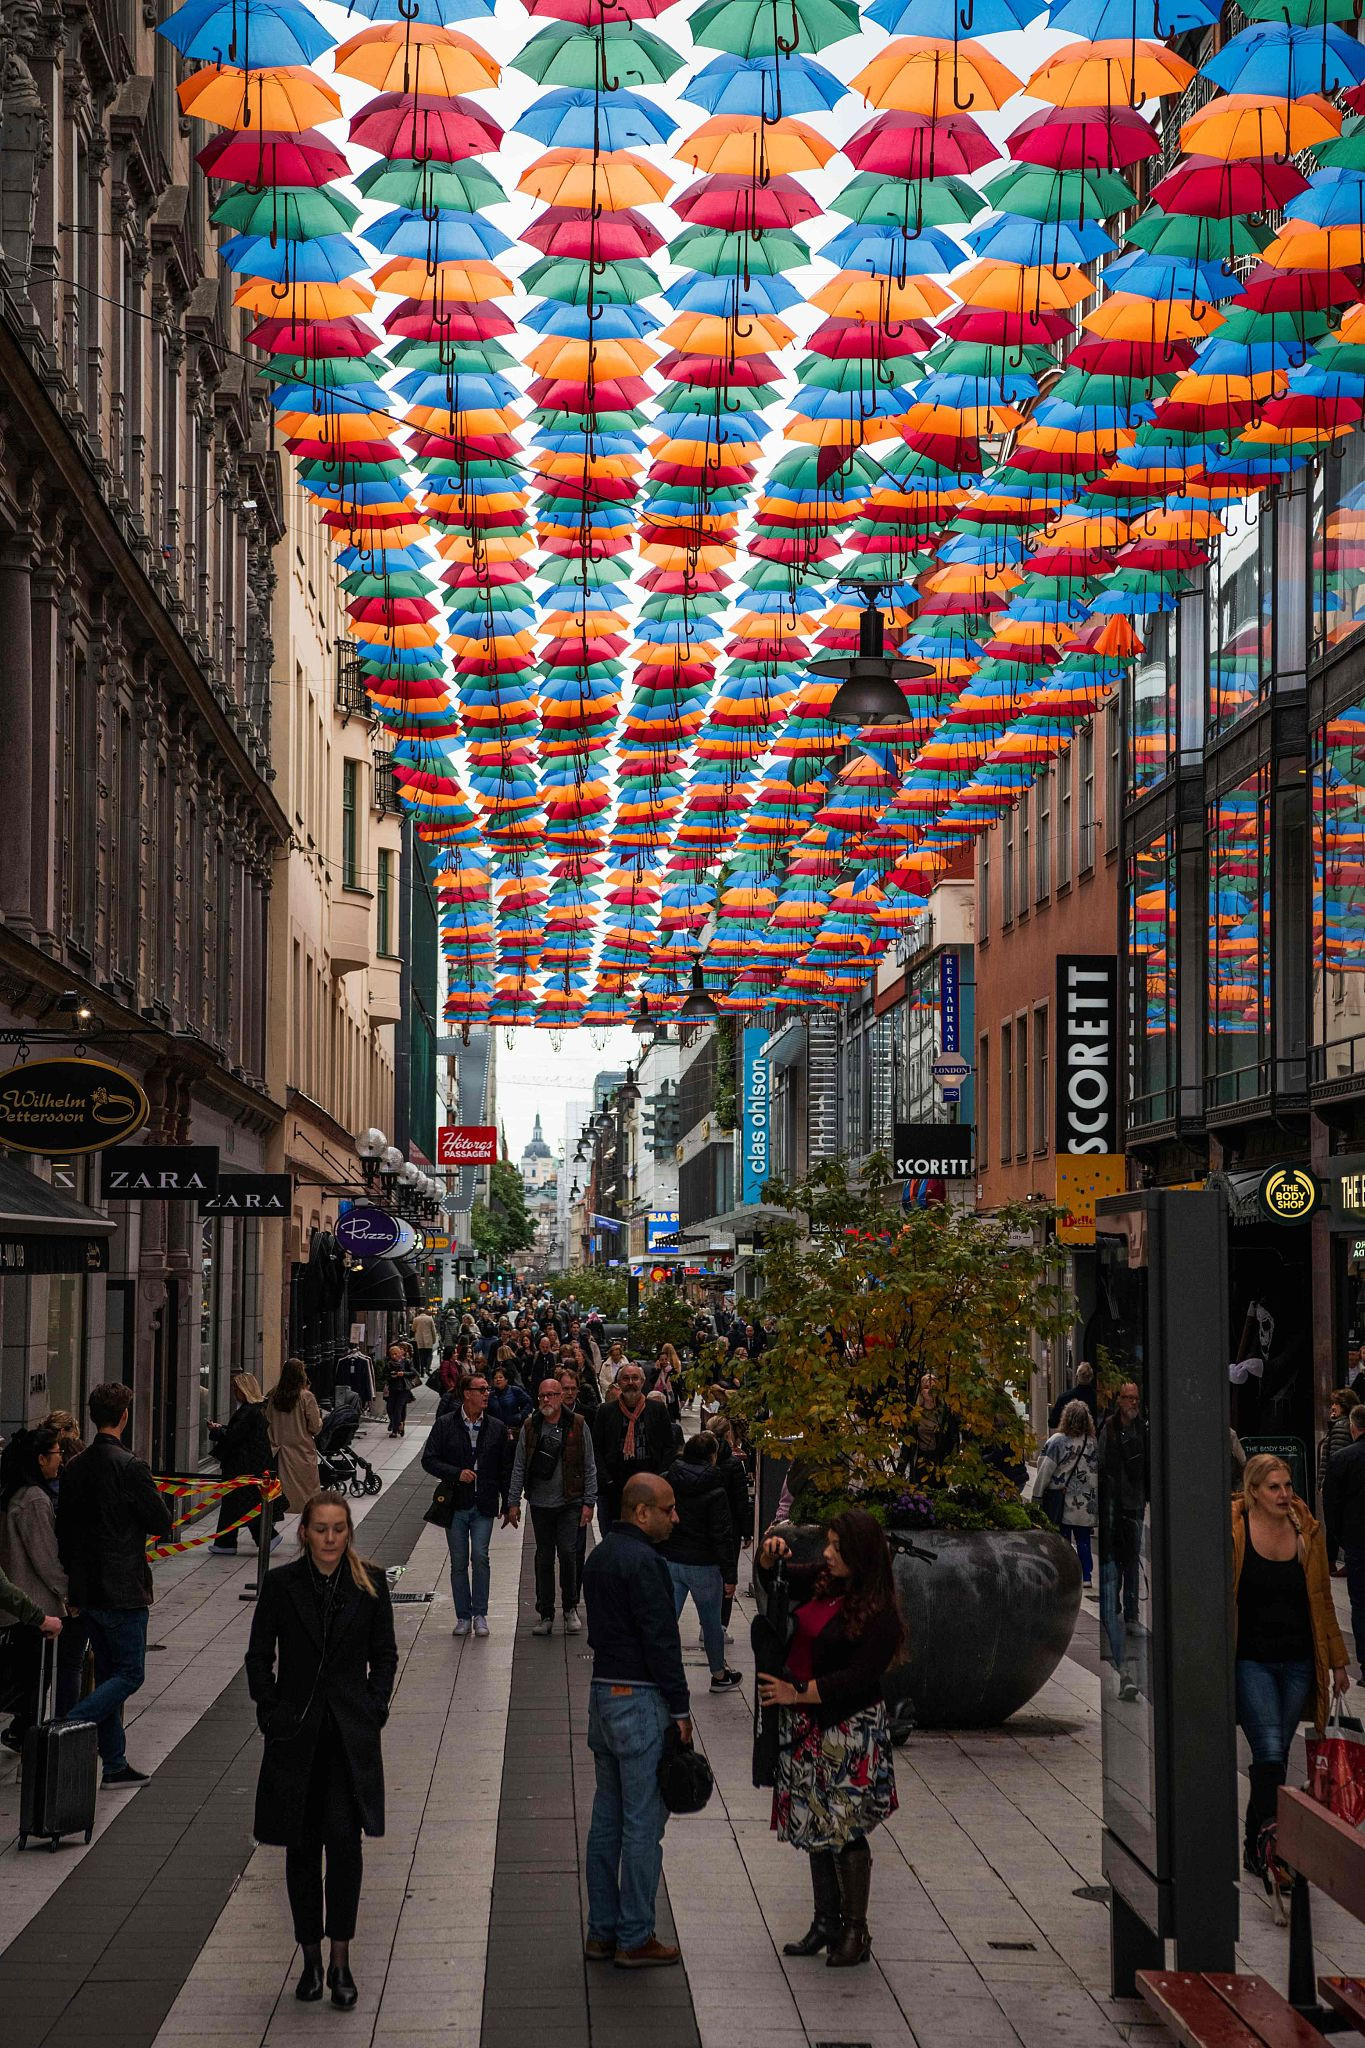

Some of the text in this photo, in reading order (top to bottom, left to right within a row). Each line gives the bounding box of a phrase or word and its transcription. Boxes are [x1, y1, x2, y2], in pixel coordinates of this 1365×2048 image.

[945, 957, 954, 1052] RESTAURANG
[1068, 965, 1109, 1154] SCORETT
[933, 1067, 968, 1075] LONDON
[2, 1090, 86, 1108] Wilhelm
[747, 1059, 767, 1174] clas ohlson
[442, 1132, 494, 1151] Hötorgs
[444, 1150, 491, 1158] PASSAGEN
[896, 1158, 969, 1175] SCORETT
[109, 1171, 207, 1189] ZARA
[1281, 1184, 1299, 1192] THE
[1275, 1192, 1306, 1200] BODY
[1341, 1175, 1360, 1209] THE
[1277, 1201, 1305, 1209] SHOP
[340, 1217, 394, 1240] Rizzo
